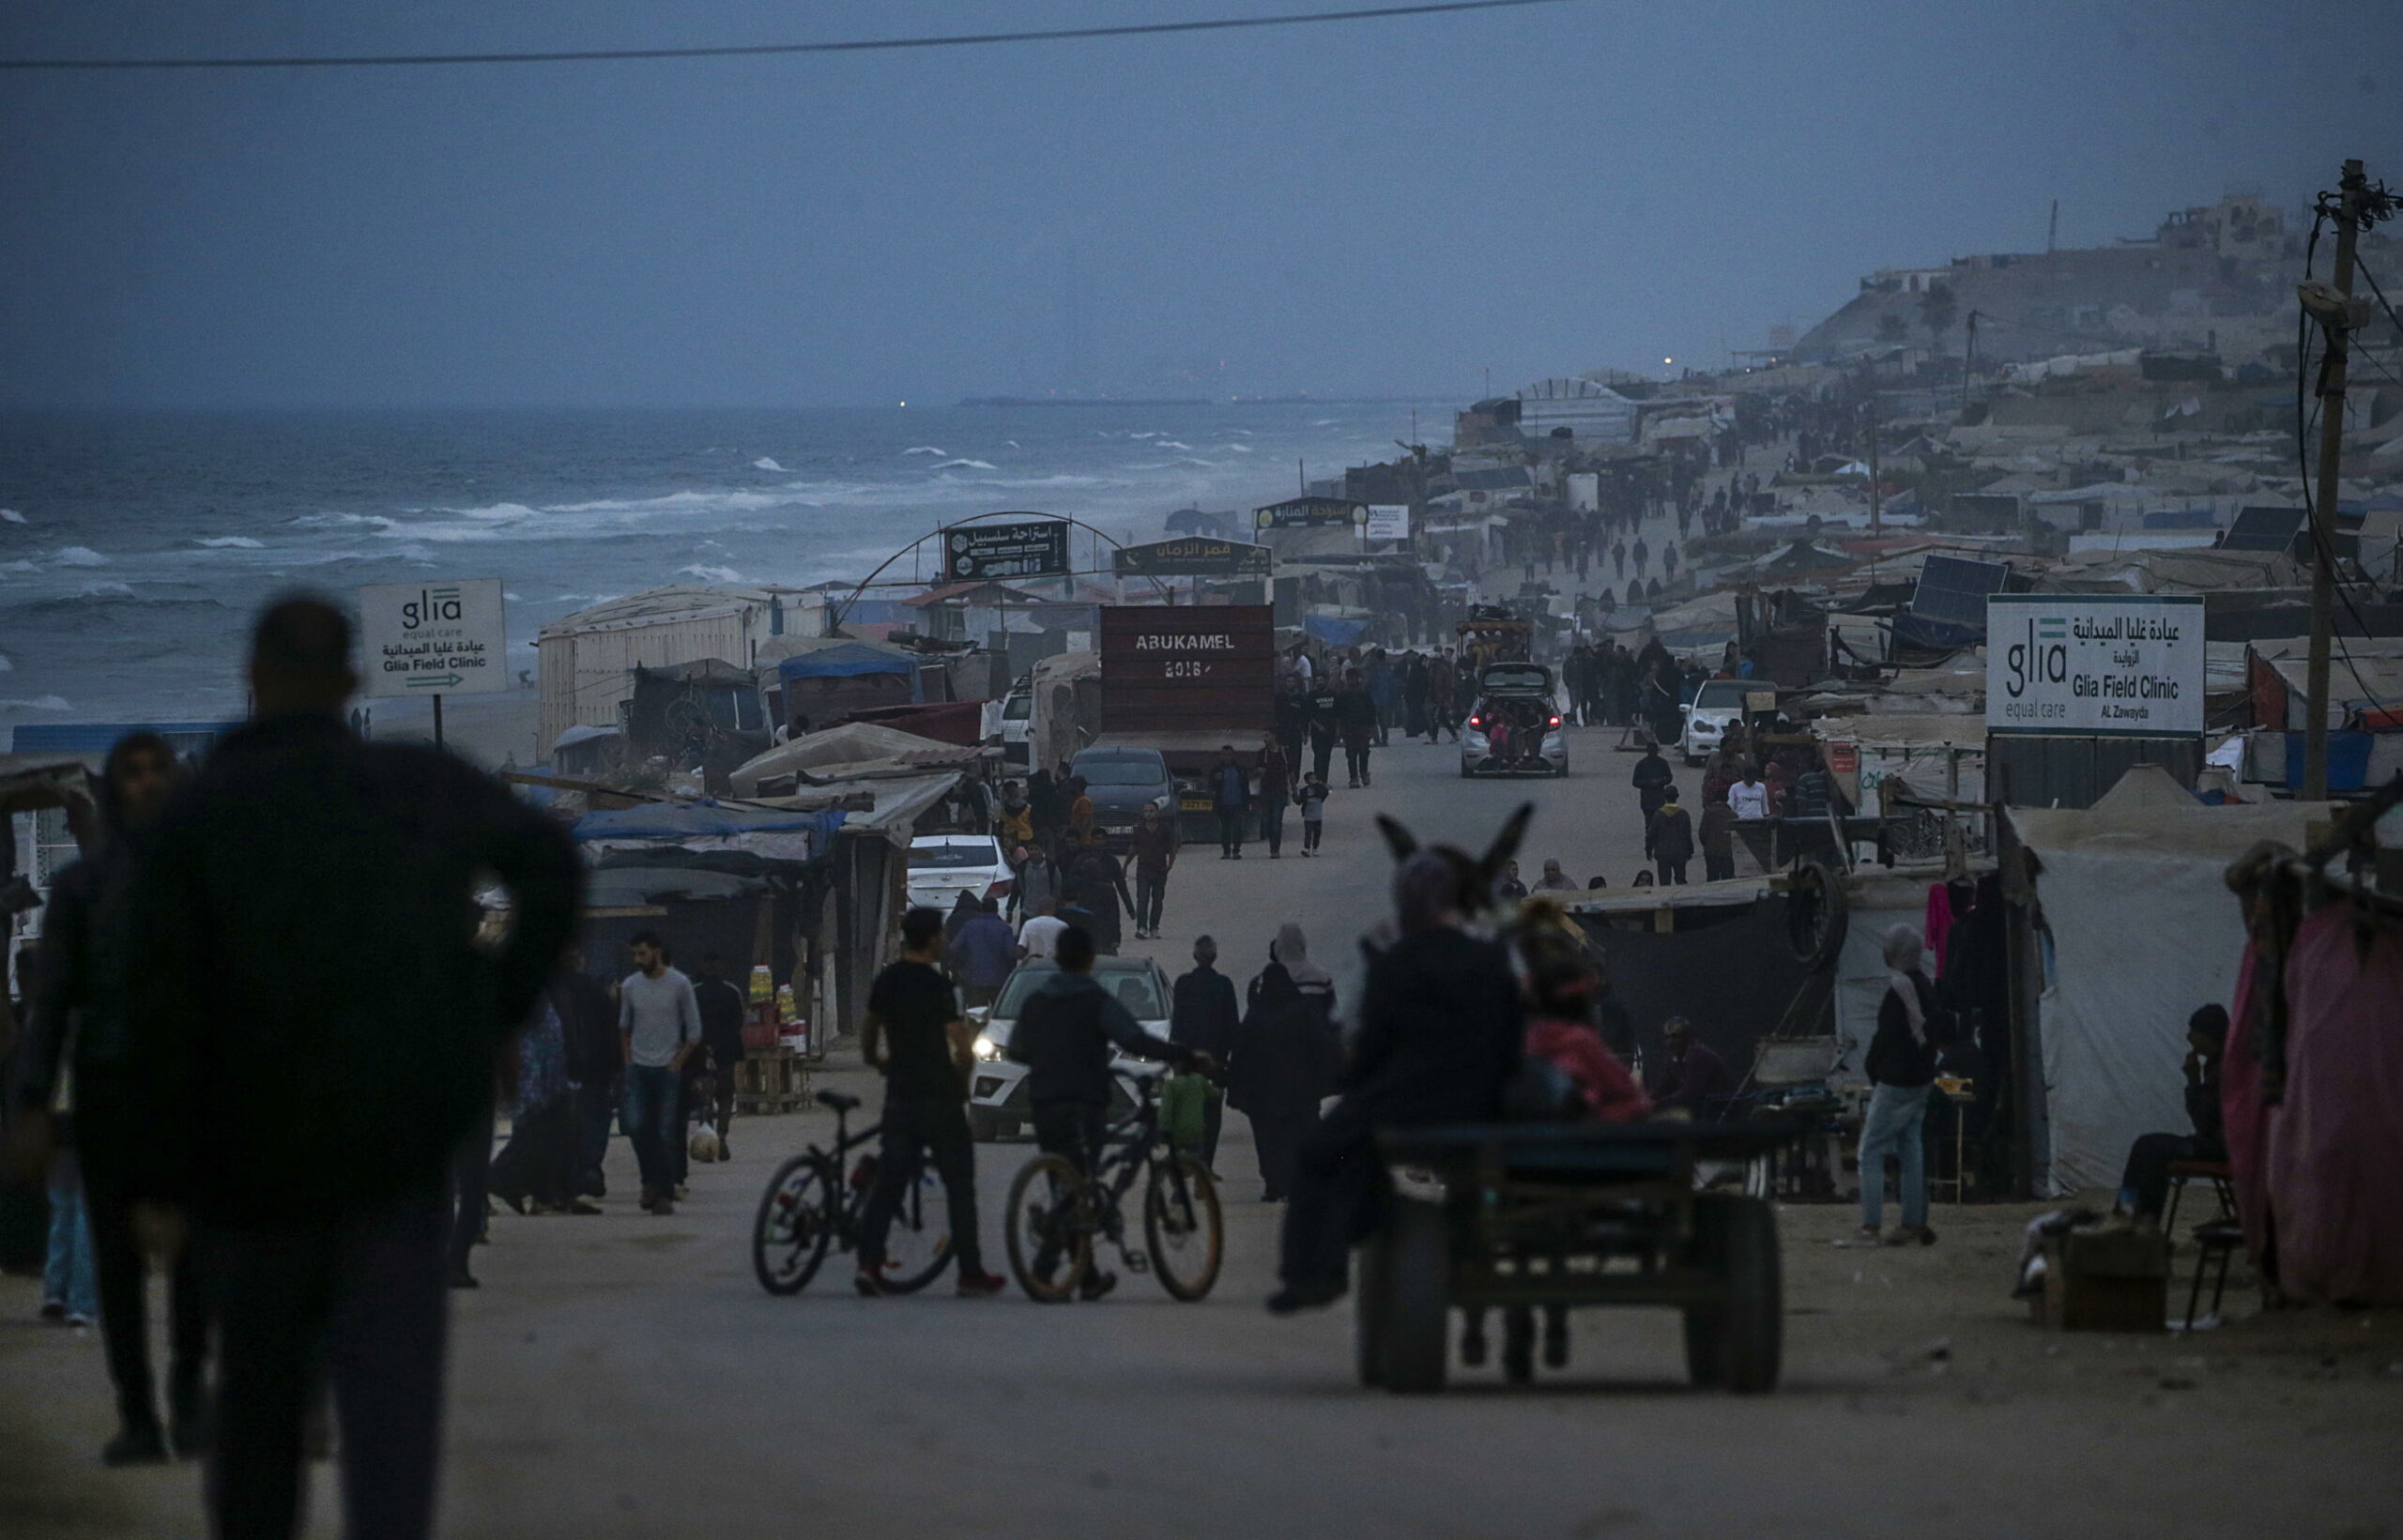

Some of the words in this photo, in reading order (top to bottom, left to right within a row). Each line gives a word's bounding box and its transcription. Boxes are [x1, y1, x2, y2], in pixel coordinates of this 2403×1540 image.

[968, 529, 1010, 547] سلسبيل
[1012, 525, 1051, 541] استراحة
[1156, 541, 1200, 557] الزمان
[1204, 542, 1232, 557] قمر
[402, 589, 462, 630] glia
[403, 628, 436, 640] equal
[437, 629, 463, 637] care
[2073, 616, 2122, 647] الميدانية
[2126, 617, 2147, 648] غليا
[2150, 618, 2180, 648] عيادة
[433, 642, 454, 657] غليا
[457, 640, 486, 655] عيادة
[1136, 634, 1235, 650] ABUKAMEL
[382, 643, 430, 659] الميدانية
[2006, 618, 2067, 698] glia
[2113, 649, 2140, 668] الزوايدة
[383, 660, 410, 672] Glia
[413, 658, 446, 671] Field
[449, 657, 486, 669] Clinic
[2073, 674, 2099, 697] Glia
[2103, 675, 2137, 698] Field
[2140, 675, 2179, 699] Clinic
[2006, 698, 2038, 722] equal
[2041, 702, 2066, 719] care
[2113, 705, 2149, 722] Zawayda
